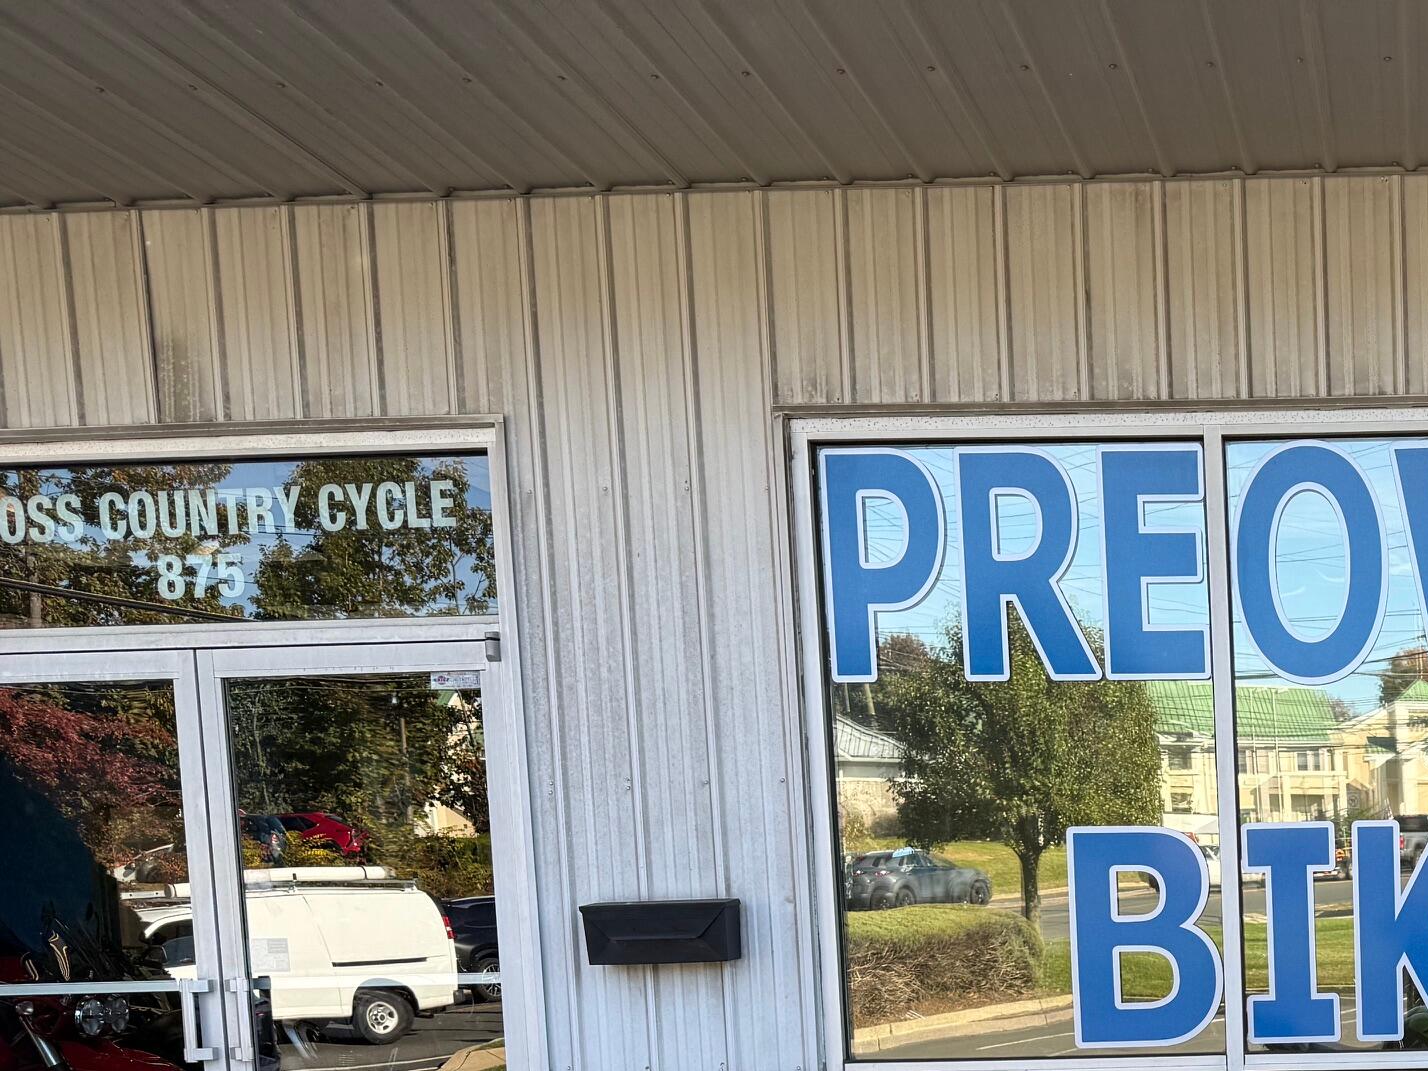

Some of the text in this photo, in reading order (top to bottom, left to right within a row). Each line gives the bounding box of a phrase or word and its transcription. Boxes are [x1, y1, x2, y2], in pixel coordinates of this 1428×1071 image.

[0, 480, 457, 544] OSS COUNTRY CYCLE
[157, 553, 246, 601] 875
